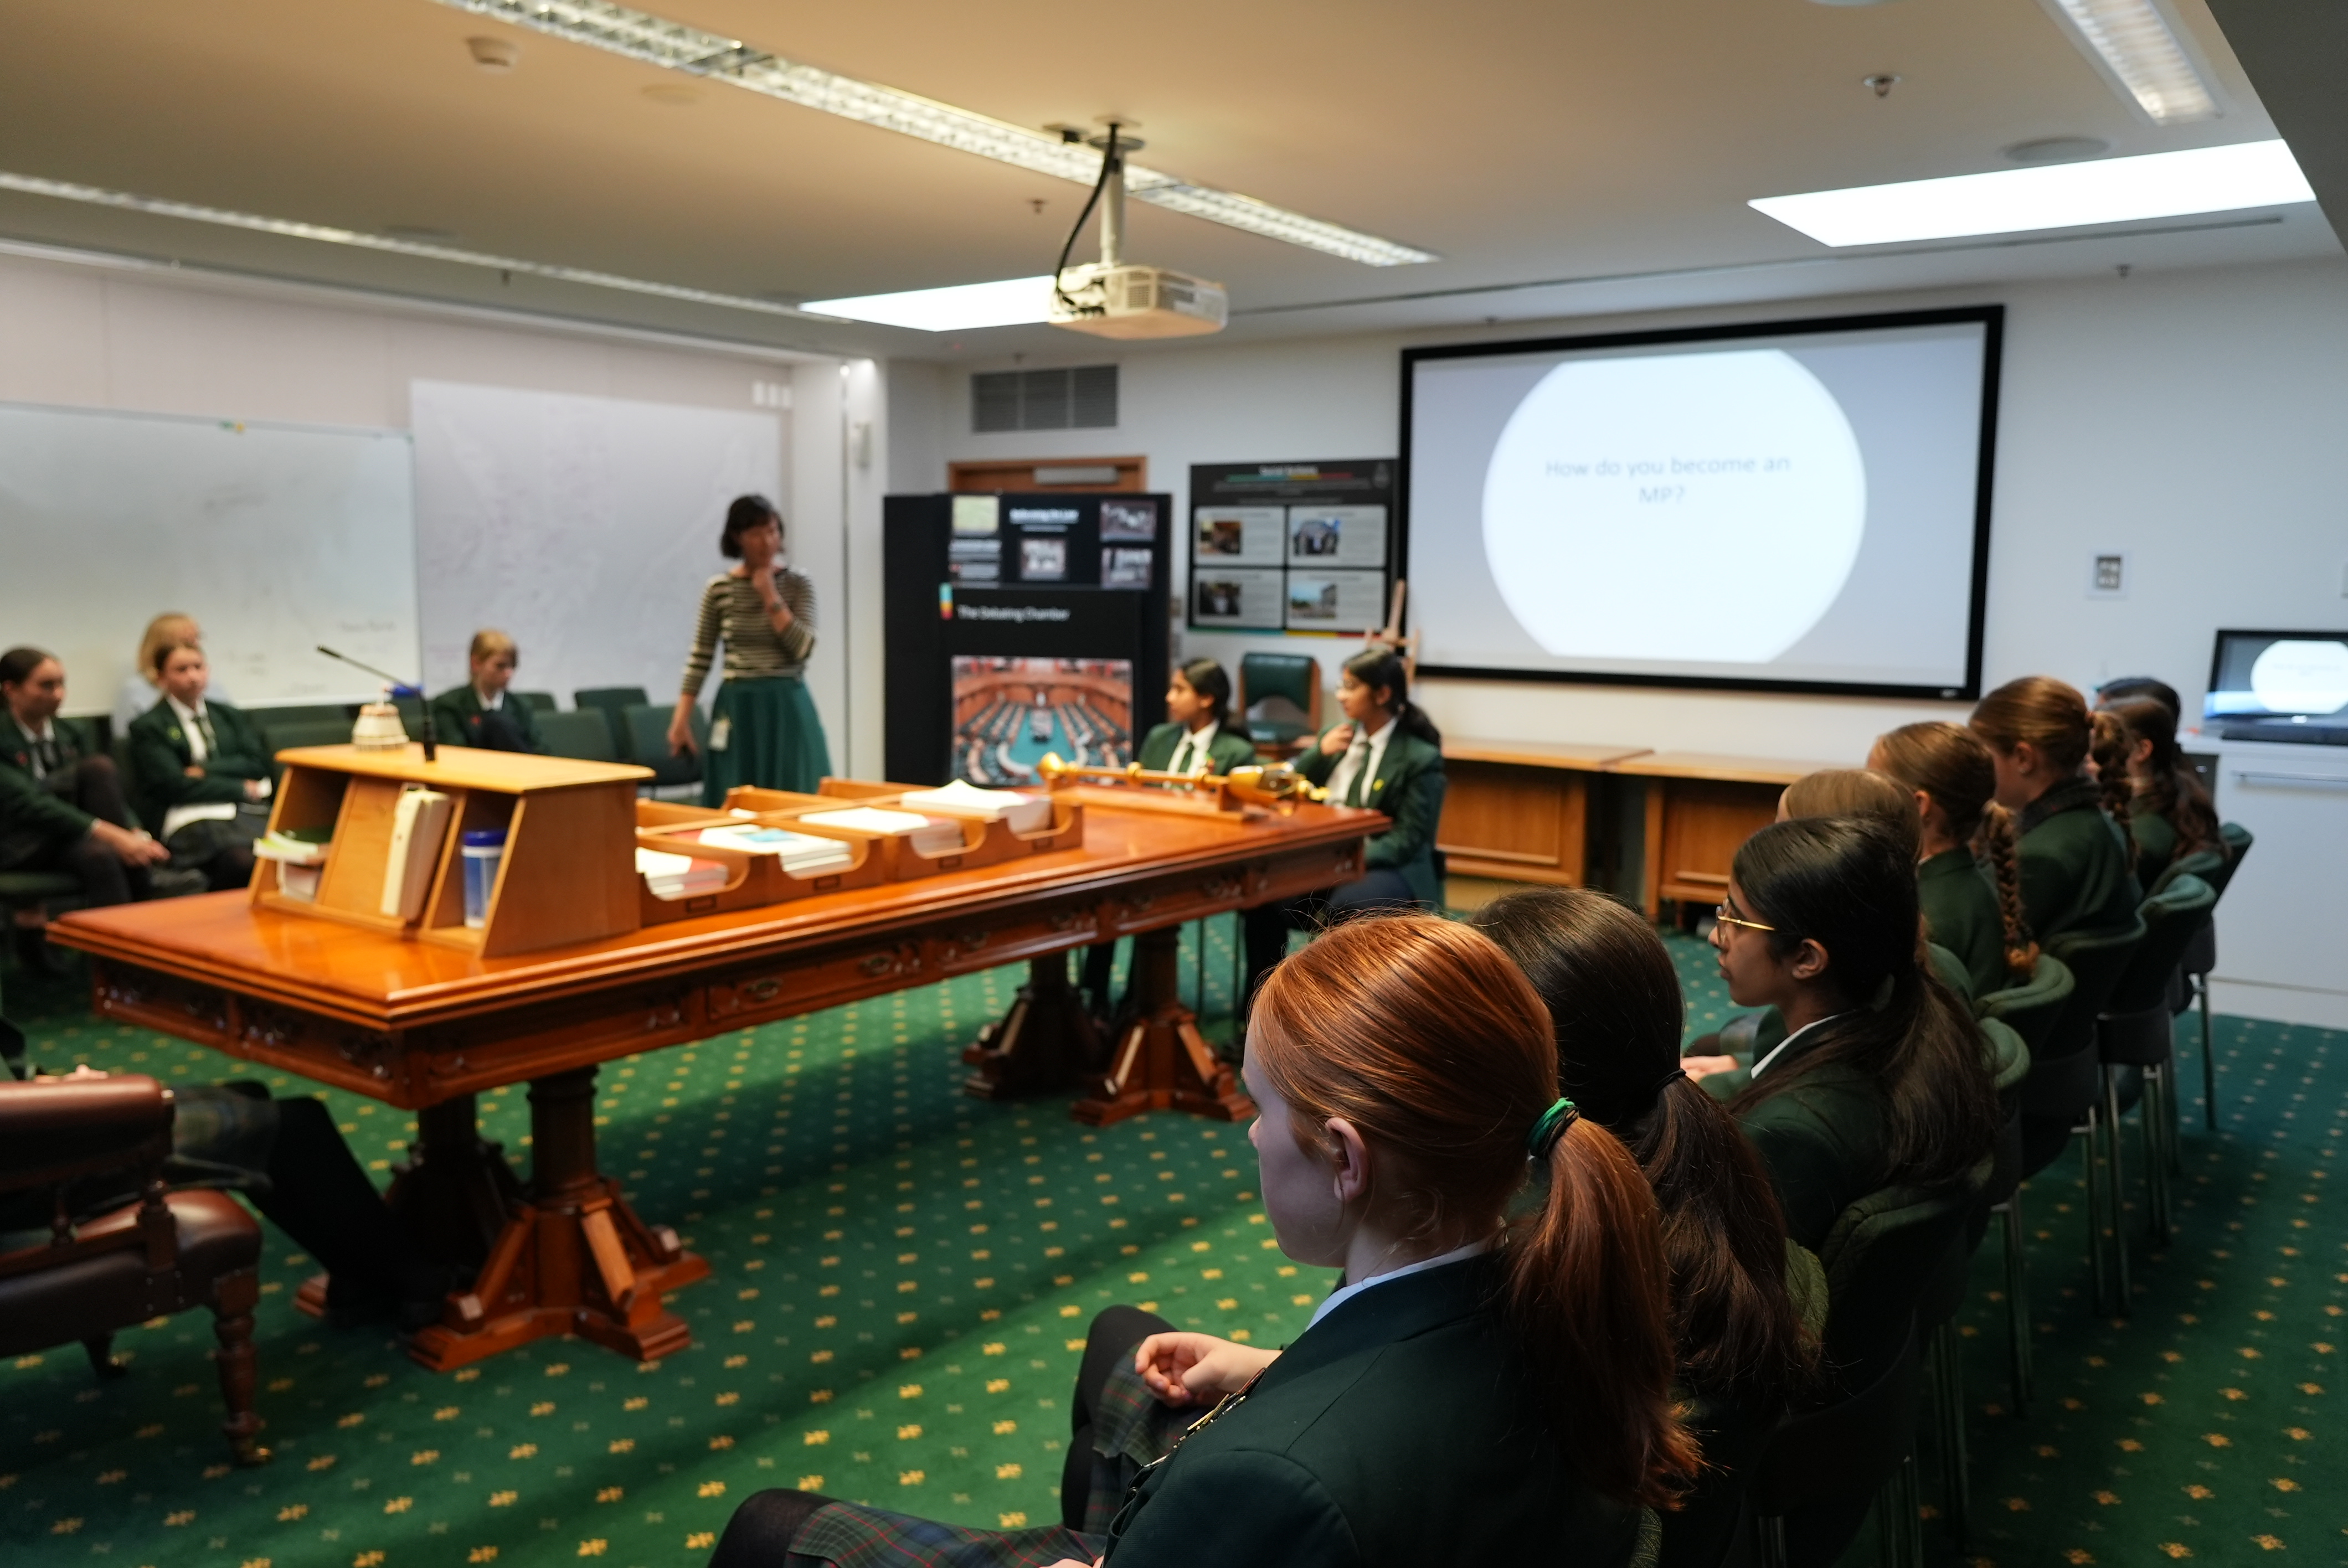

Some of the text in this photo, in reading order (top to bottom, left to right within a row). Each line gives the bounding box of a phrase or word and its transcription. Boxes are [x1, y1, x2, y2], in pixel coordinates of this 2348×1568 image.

[1546, 457, 1791, 479] How do you become an
[1639, 486, 1686, 504] MP?
[957, 605, 1070, 623] The Debating Chamber
